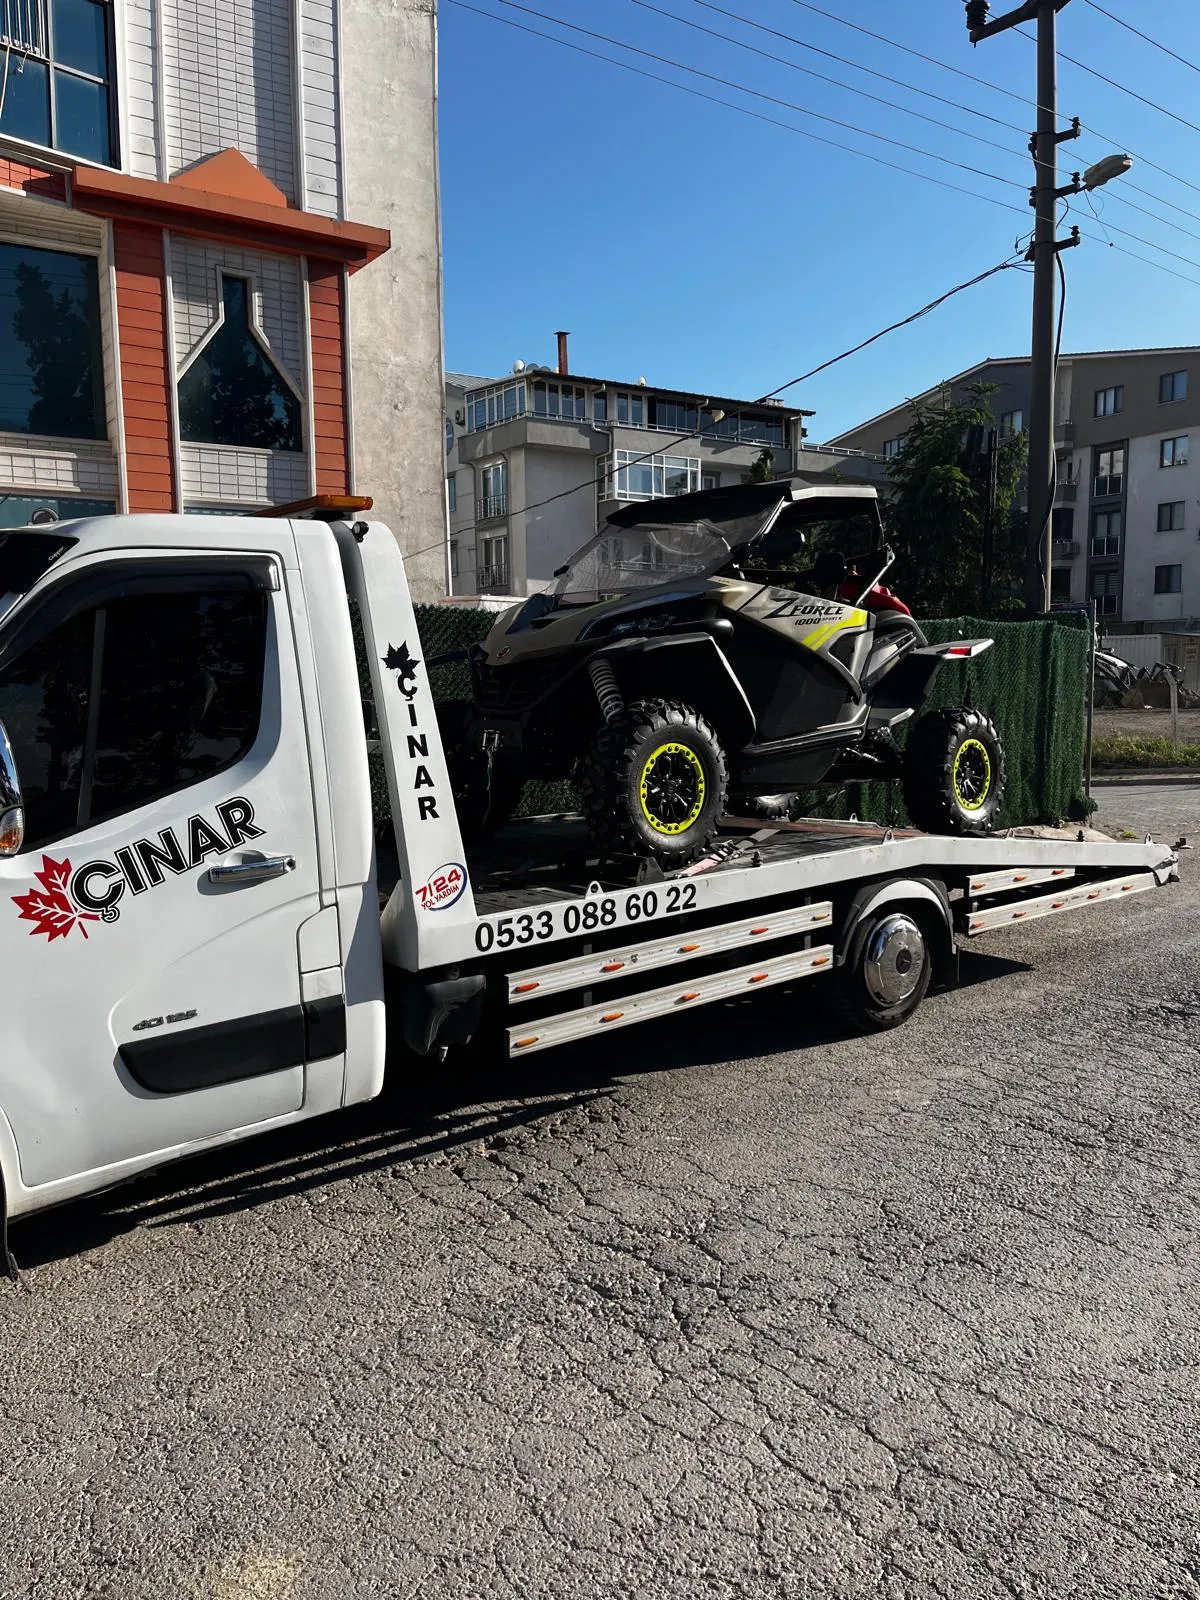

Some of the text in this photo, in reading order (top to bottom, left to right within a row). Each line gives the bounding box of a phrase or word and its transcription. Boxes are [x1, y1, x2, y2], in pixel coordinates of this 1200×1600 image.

[794, 617, 821, 626] 1000
[397, 673, 440, 821] ÇINAR
[70, 796, 267, 923] ÇINAR
[421, 883, 460, 911] YOL YARDIM
[474, 883, 697, 952] 0533 088 60 22
